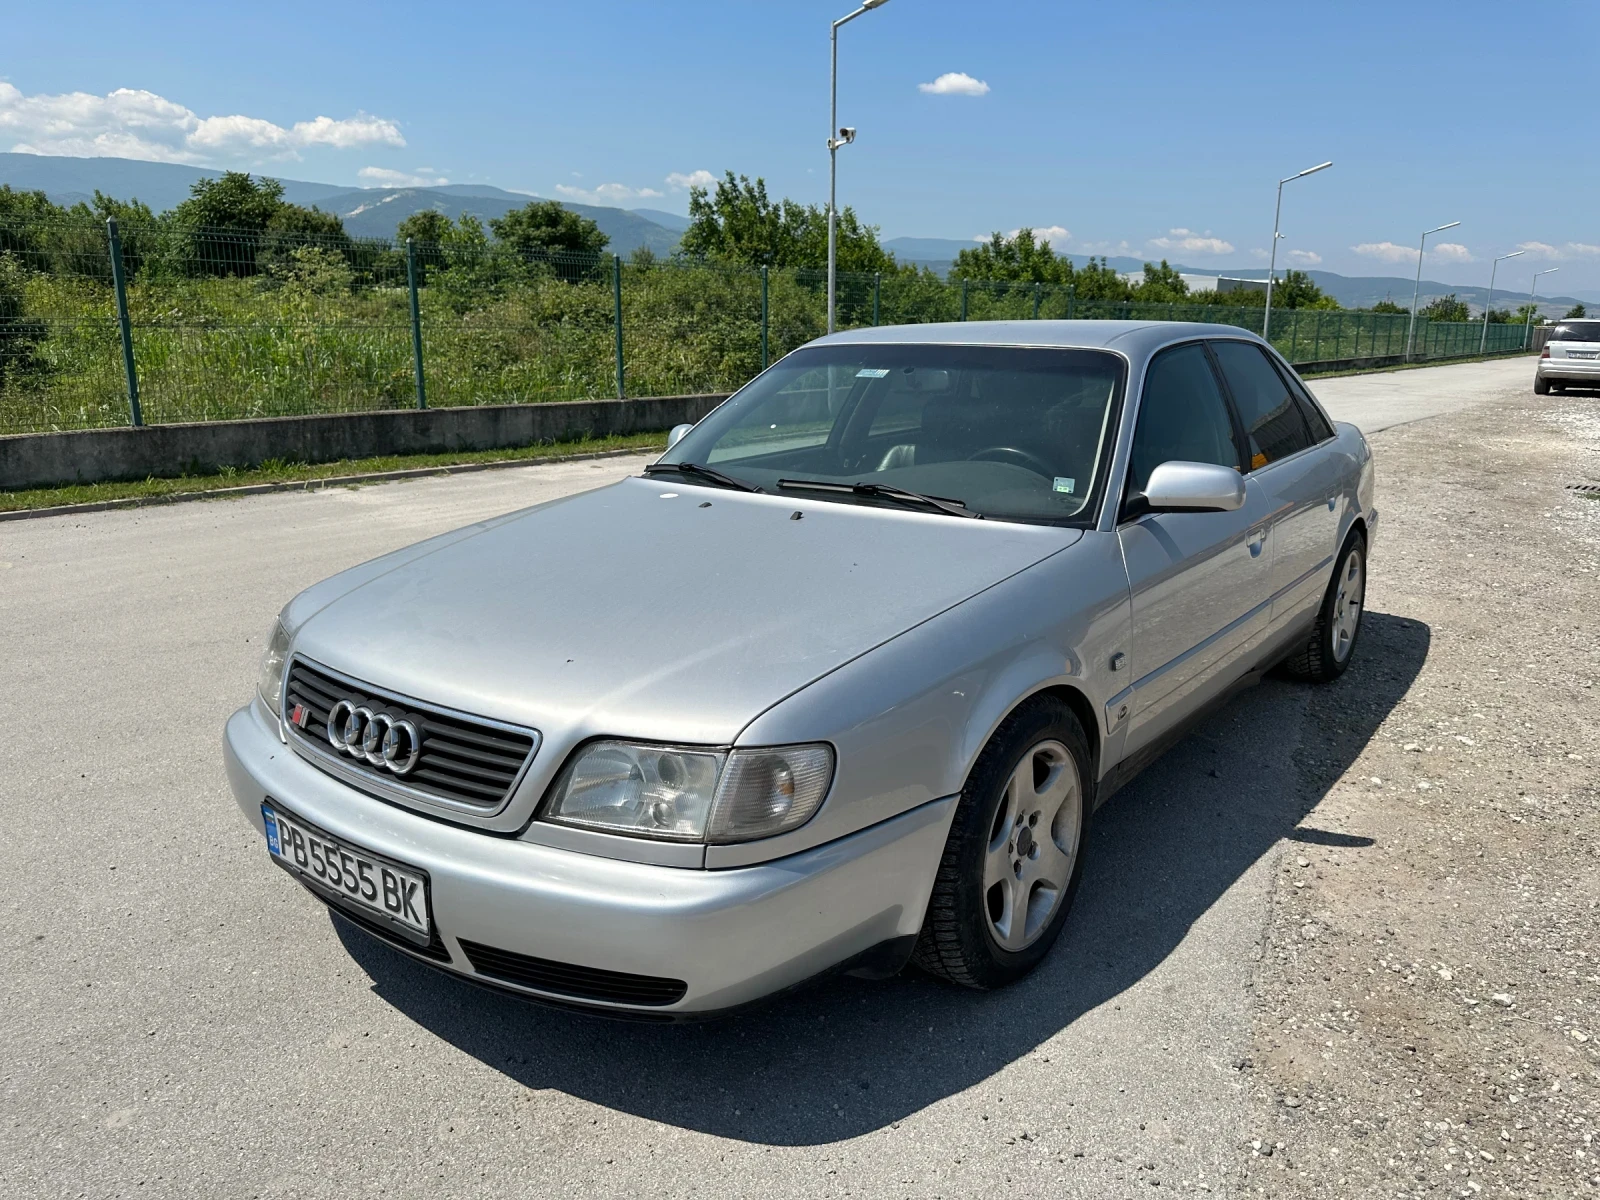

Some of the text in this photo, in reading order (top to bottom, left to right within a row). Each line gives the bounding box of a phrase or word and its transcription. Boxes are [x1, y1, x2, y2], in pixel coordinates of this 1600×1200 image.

[269, 834, 279, 849] BG
[277, 817, 422, 925] PB 5555 BK
